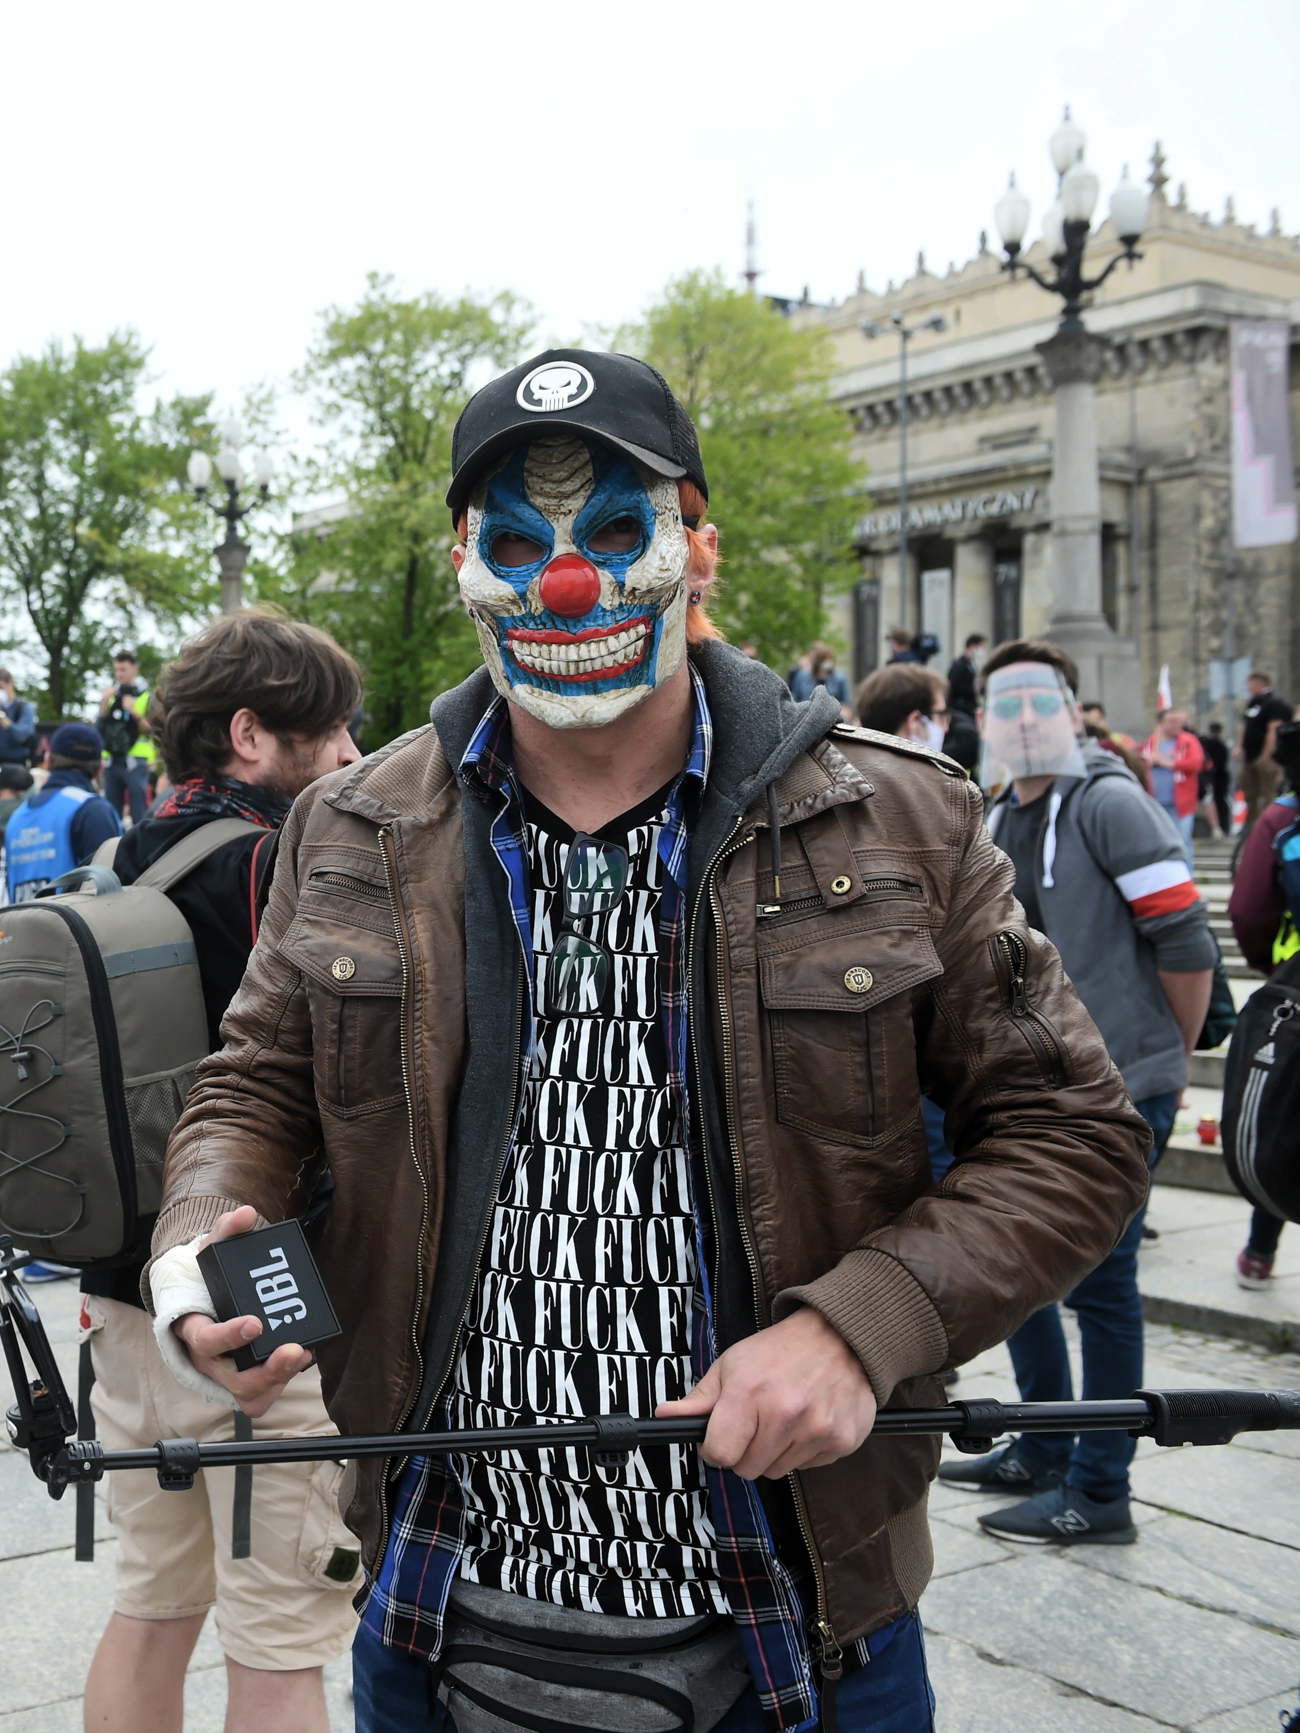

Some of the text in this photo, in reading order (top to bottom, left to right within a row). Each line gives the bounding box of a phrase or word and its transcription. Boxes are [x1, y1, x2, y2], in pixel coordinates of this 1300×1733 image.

[567, 889, 662, 954] FUCK
[549, 1017, 656, 1086] FUCK
[540, 1145, 644, 1216] FUCK
[490, 1206, 697, 1285] FUCK FUCK
[249, 1247, 307, 1321] JBL
[534, 1279, 649, 1353] FUCK
[481, 1337, 587, 1418] FUCK
[486, 1465, 602, 1536] FUCK
[605, 1487, 717, 1548] FUCK
